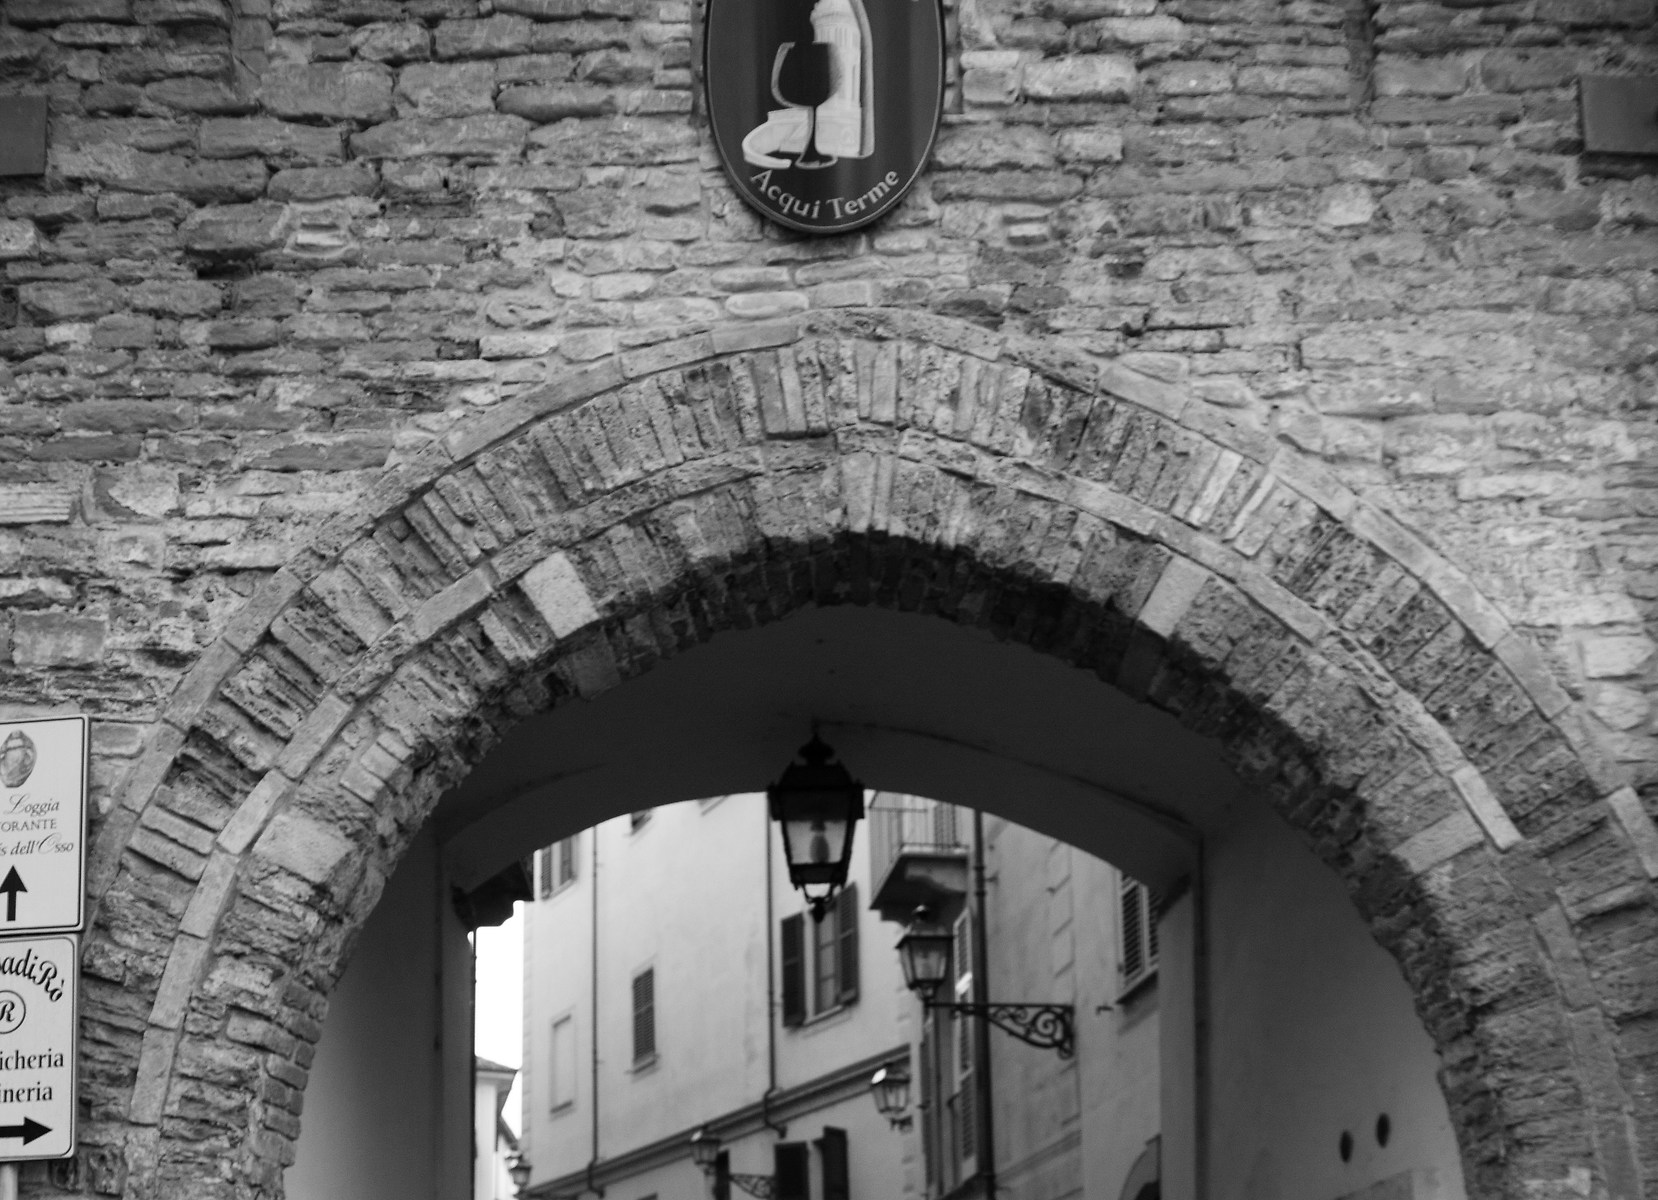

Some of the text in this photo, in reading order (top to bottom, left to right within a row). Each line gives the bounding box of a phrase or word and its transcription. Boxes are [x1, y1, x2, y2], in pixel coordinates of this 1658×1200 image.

[750, 169, 899, 219] Acqui Terme
[3, 793, 60, 817] Loggia
[0, 818, 57, 833] ORANTE
[0, 1081, 53, 1103] neria
